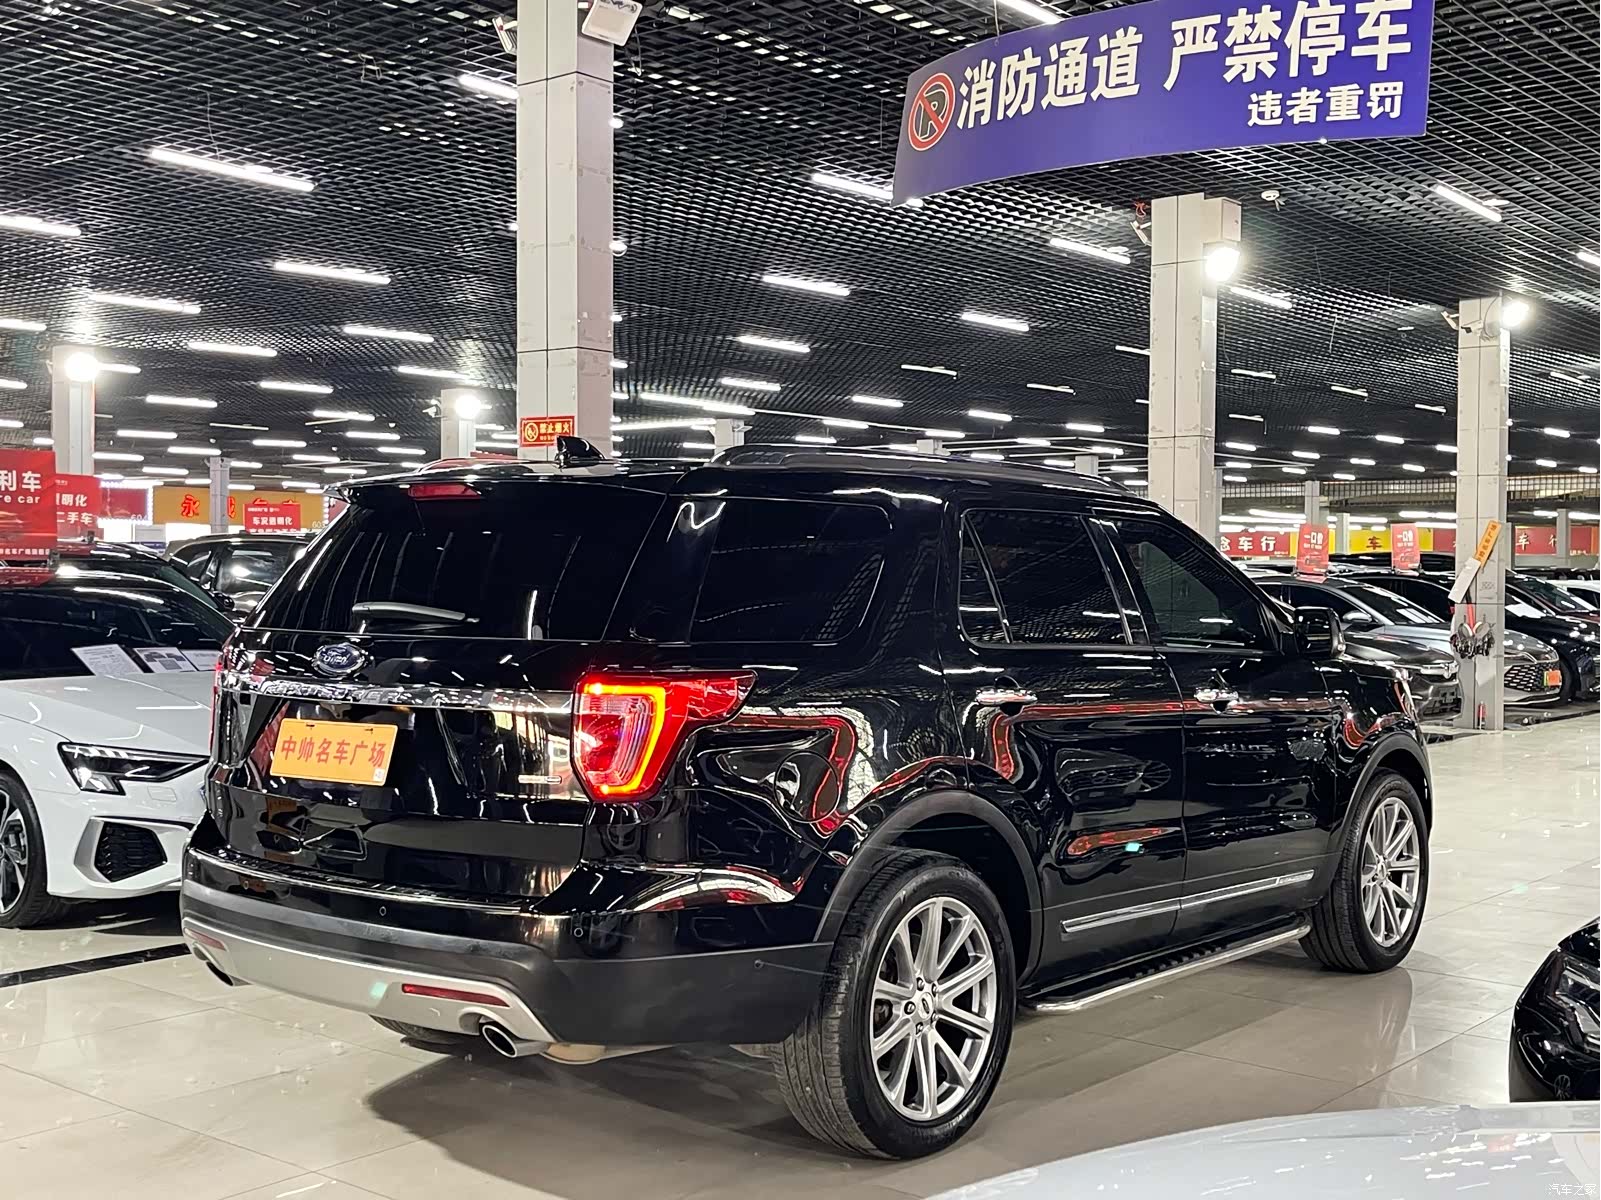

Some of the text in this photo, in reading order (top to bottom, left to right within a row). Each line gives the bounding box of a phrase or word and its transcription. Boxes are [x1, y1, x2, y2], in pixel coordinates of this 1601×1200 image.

[956, 0, 1413, 130] 消防通道 严禁停车
[1247, 81, 1404, 127] 违者重罚
[17, 495, 40, 504] car
[281, 735, 386, 768] 中帅名车广场
